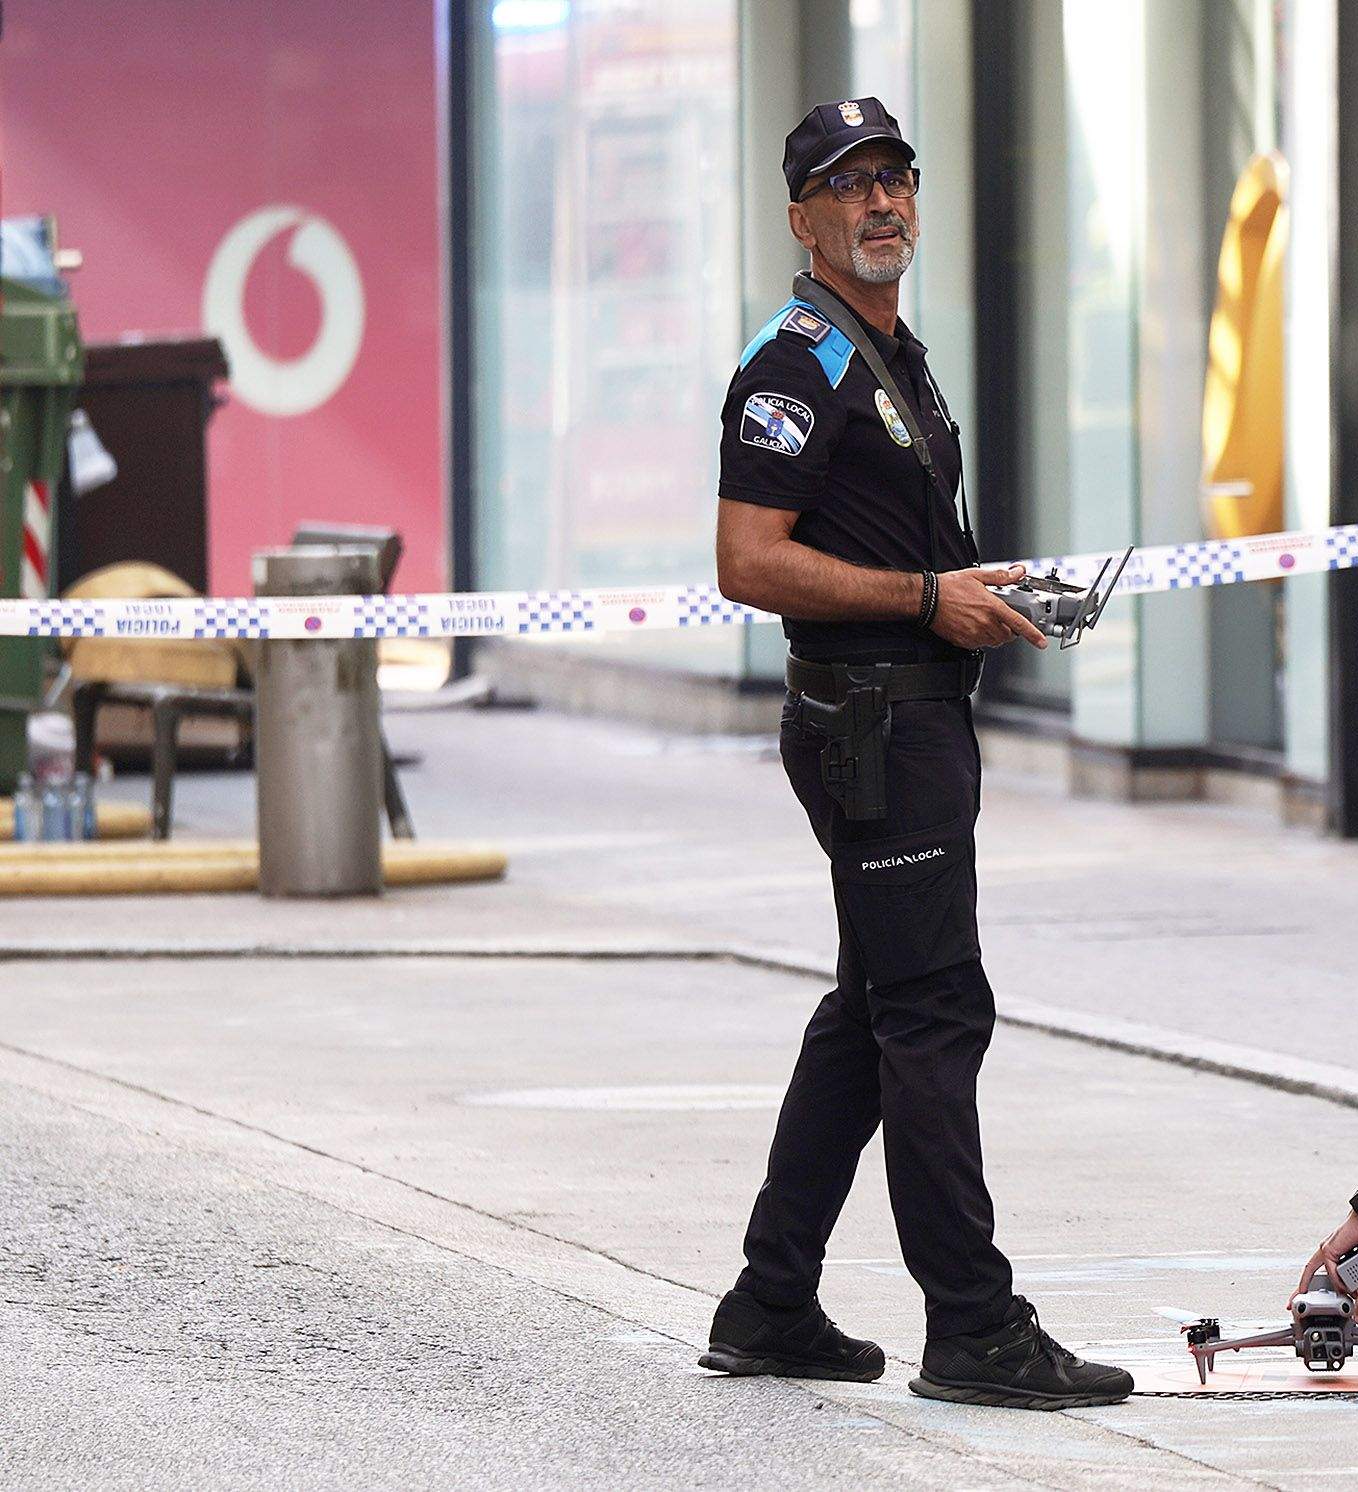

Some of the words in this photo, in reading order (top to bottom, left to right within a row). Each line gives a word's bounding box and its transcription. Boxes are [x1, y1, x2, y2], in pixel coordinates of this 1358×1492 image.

[786, 403, 811, 422] LOCAL
[753, 435, 786, 451] GALICIA
[116, 620, 180, 634] POLICIA
[440, 615, 504, 632] POLICIA
[861, 856, 904, 871] POLICÍA
[912, 848, 945, 862] LOCAL
